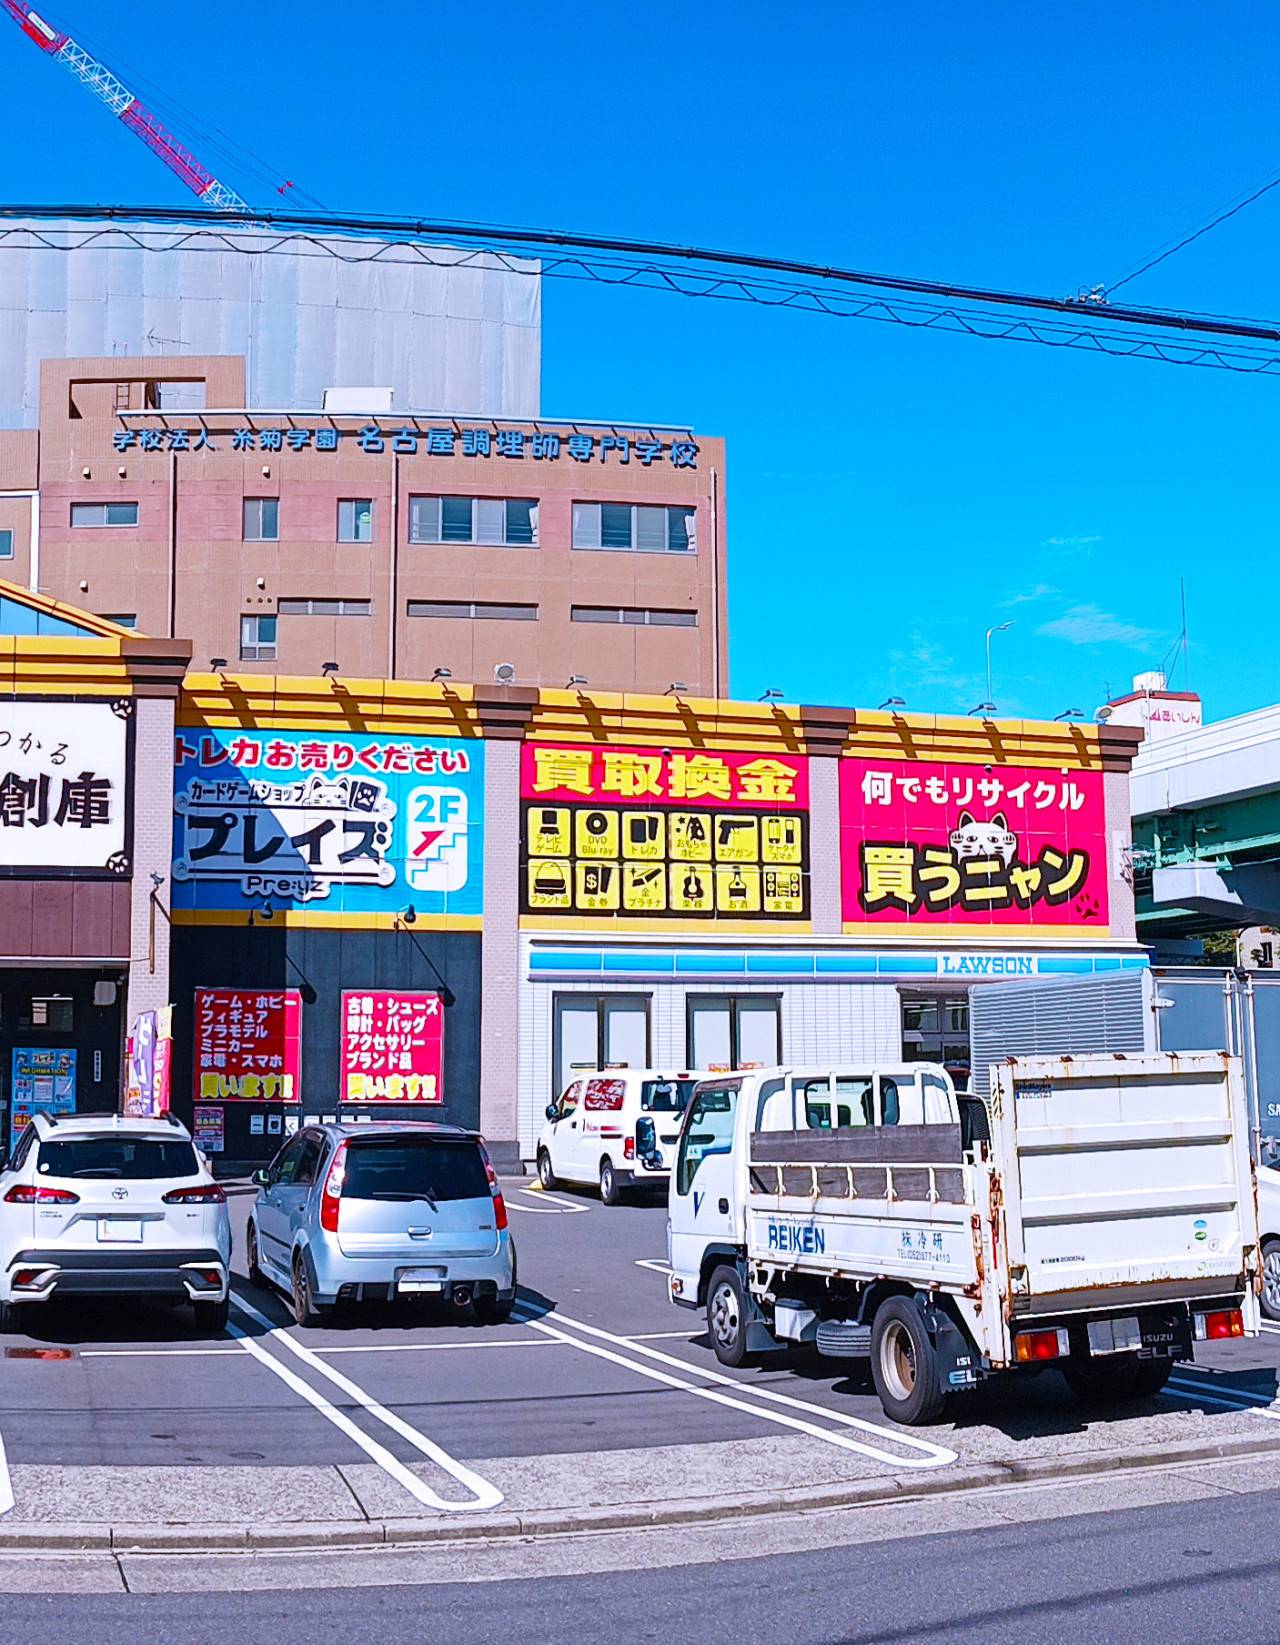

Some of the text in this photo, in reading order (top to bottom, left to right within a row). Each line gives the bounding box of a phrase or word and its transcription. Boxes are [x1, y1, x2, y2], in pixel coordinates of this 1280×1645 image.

[113, 425, 699, 468] 学校法人 糸菊学園 名古屋調理師専門学校
[176, 738, 468, 772] トレカお売りください
[532, 748, 799, 802] 買取換金
[191, 782, 306, 802] カードゲームショップ
[861, 770, 1085, 811] 何でもリサイクル
[414, 795, 461, 823] 2F
[588, 836, 607, 844] DVD
[719, 848, 754, 857] エアガン
[864, 847, 1085, 904] 買うニャン
[942, 955, 1033, 975] LAWSON
[201, 995, 297, 1009] ゲーム・ホビー
[347, 997, 438, 1015] 古着・シューズ
[201, 1010, 270, 1023] フィギュア
[347, 1015, 426, 1032] 時計・バッグ
[201, 1024, 268, 1038] プラモデル
[201, 1039, 255, 1052] ミニカー
[347, 1034, 426, 1050] アクセサリー
[347, 1051, 412, 1070] ブランド品
[768, 1224, 826, 1255] REIKEN
[1143, 1333, 1174, 1343] ISUZU
[1136, 1344, 1182, 1360] ELF
